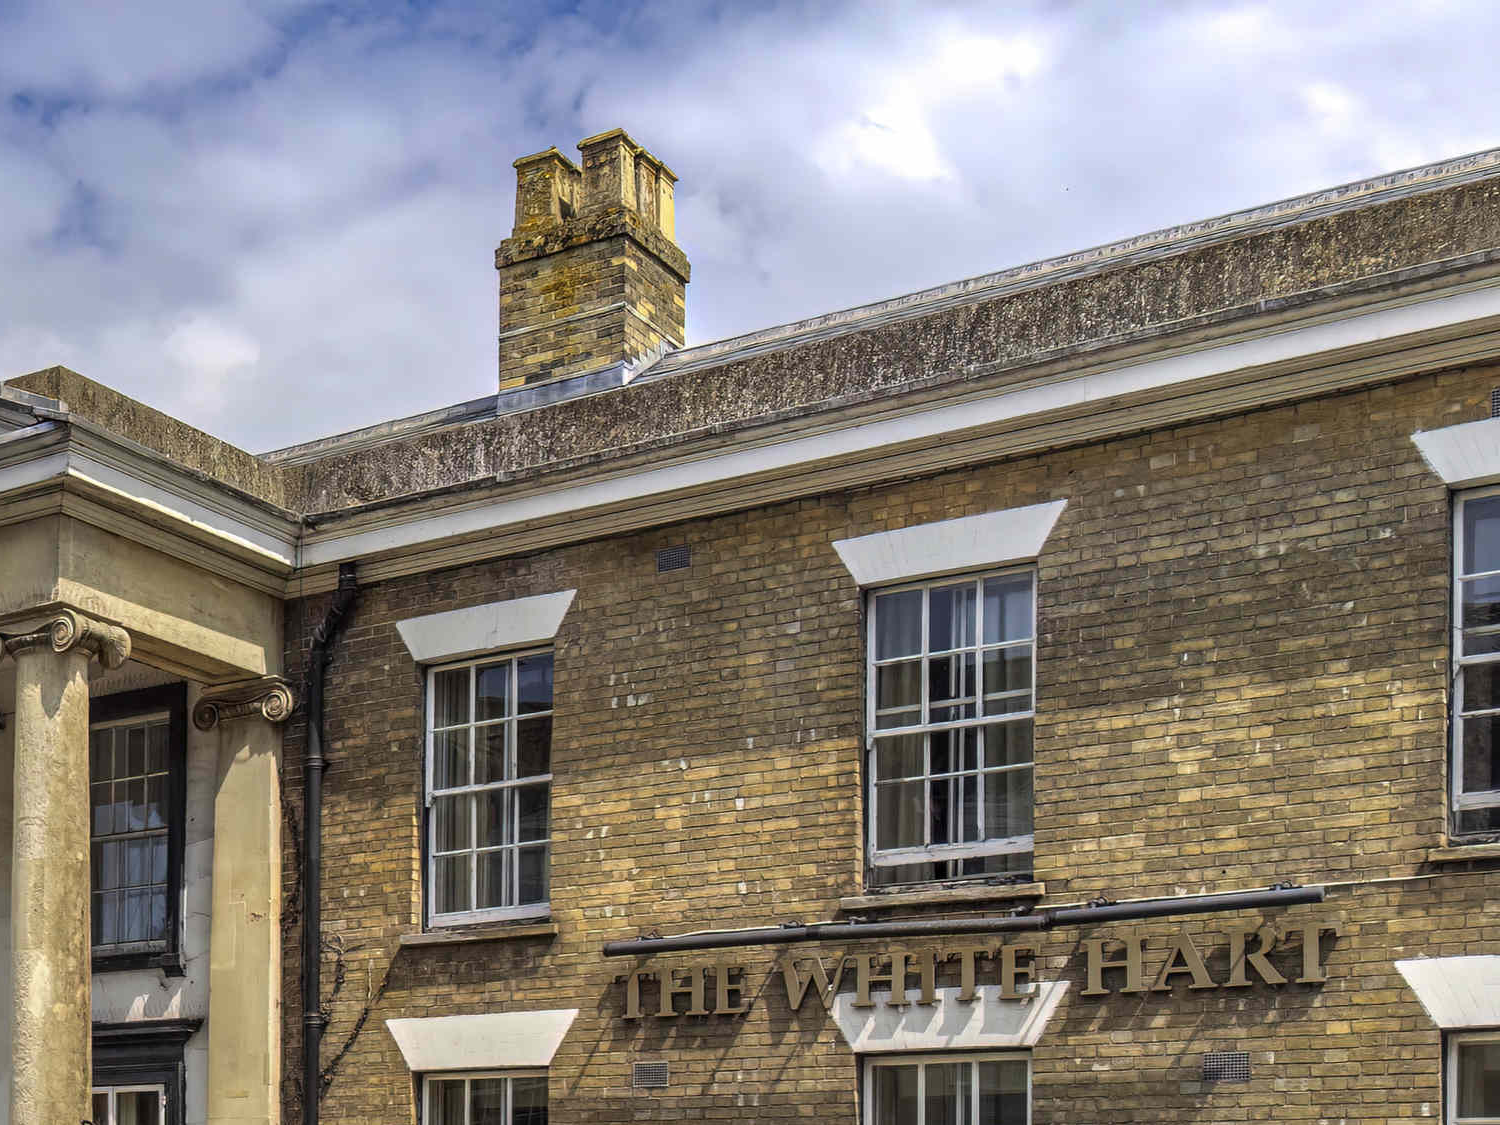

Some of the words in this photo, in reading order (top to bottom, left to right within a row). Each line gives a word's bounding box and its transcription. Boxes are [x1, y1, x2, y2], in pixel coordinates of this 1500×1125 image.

[615, 960, 749, 1019] THE
[778, 944, 1041, 1010] WHITE
[1079, 921, 1343, 996] HART
